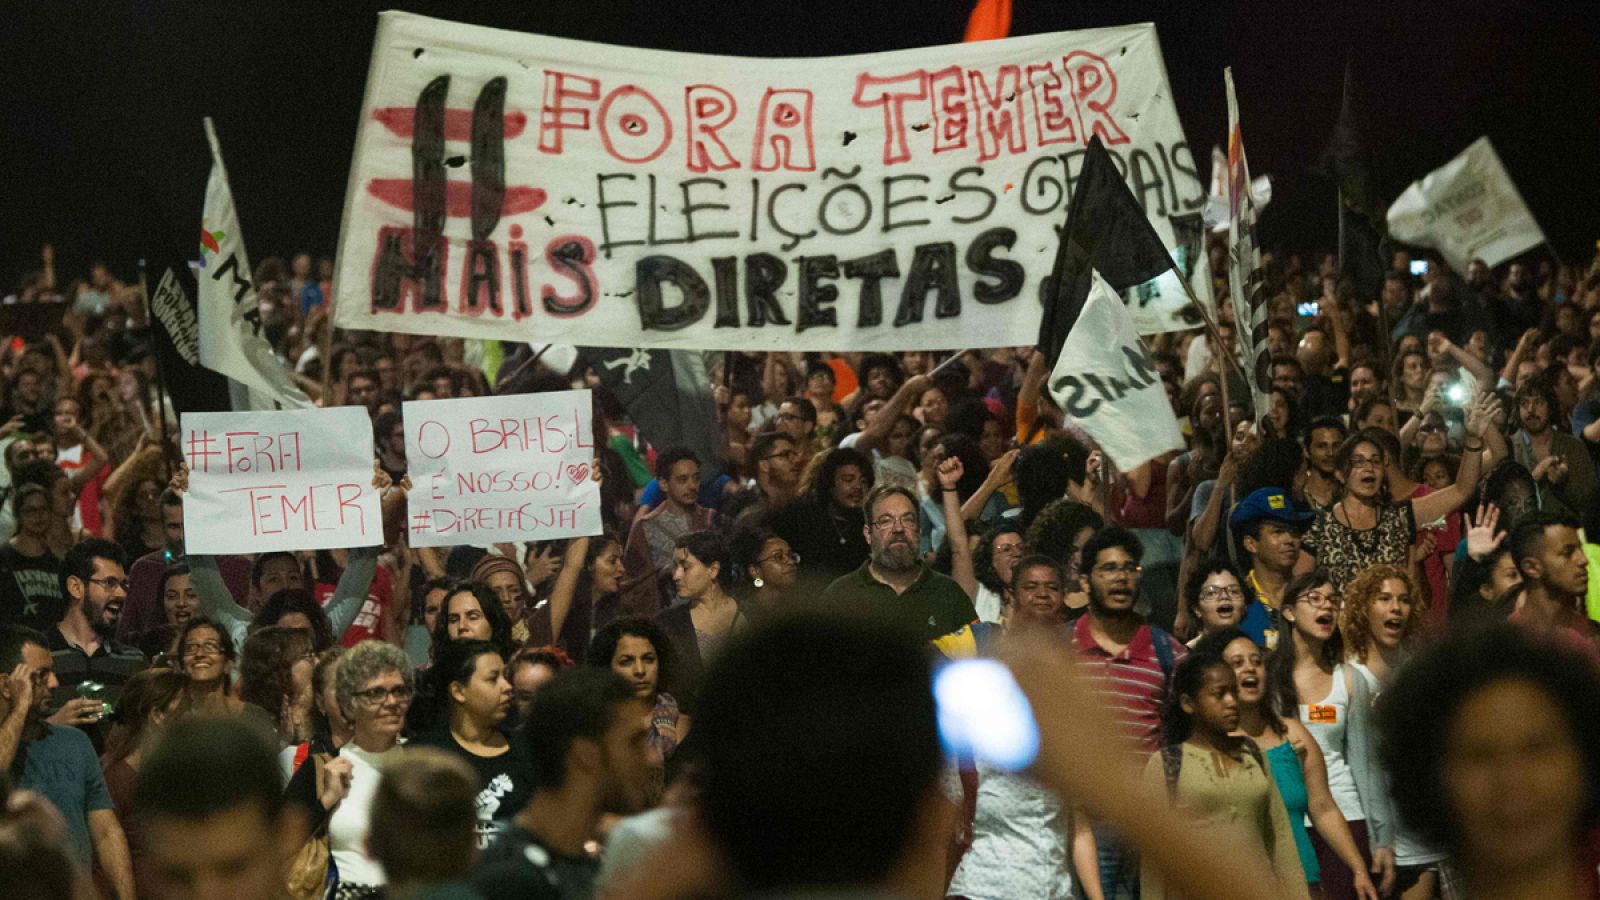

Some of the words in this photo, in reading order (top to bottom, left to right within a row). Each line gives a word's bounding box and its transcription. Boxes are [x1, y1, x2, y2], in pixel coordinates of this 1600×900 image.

[537, 69, 818, 173] FORA
[852, 50, 1131, 166] TEMER
[597, 164, 997, 259] ELEIÇÕES
[635, 227, 1026, 331] DIRETAS
[418, 420, 450, 460] O
[218, 483, 366, 536] TEMER
[457, 461, 564, 496] NOSSO!
